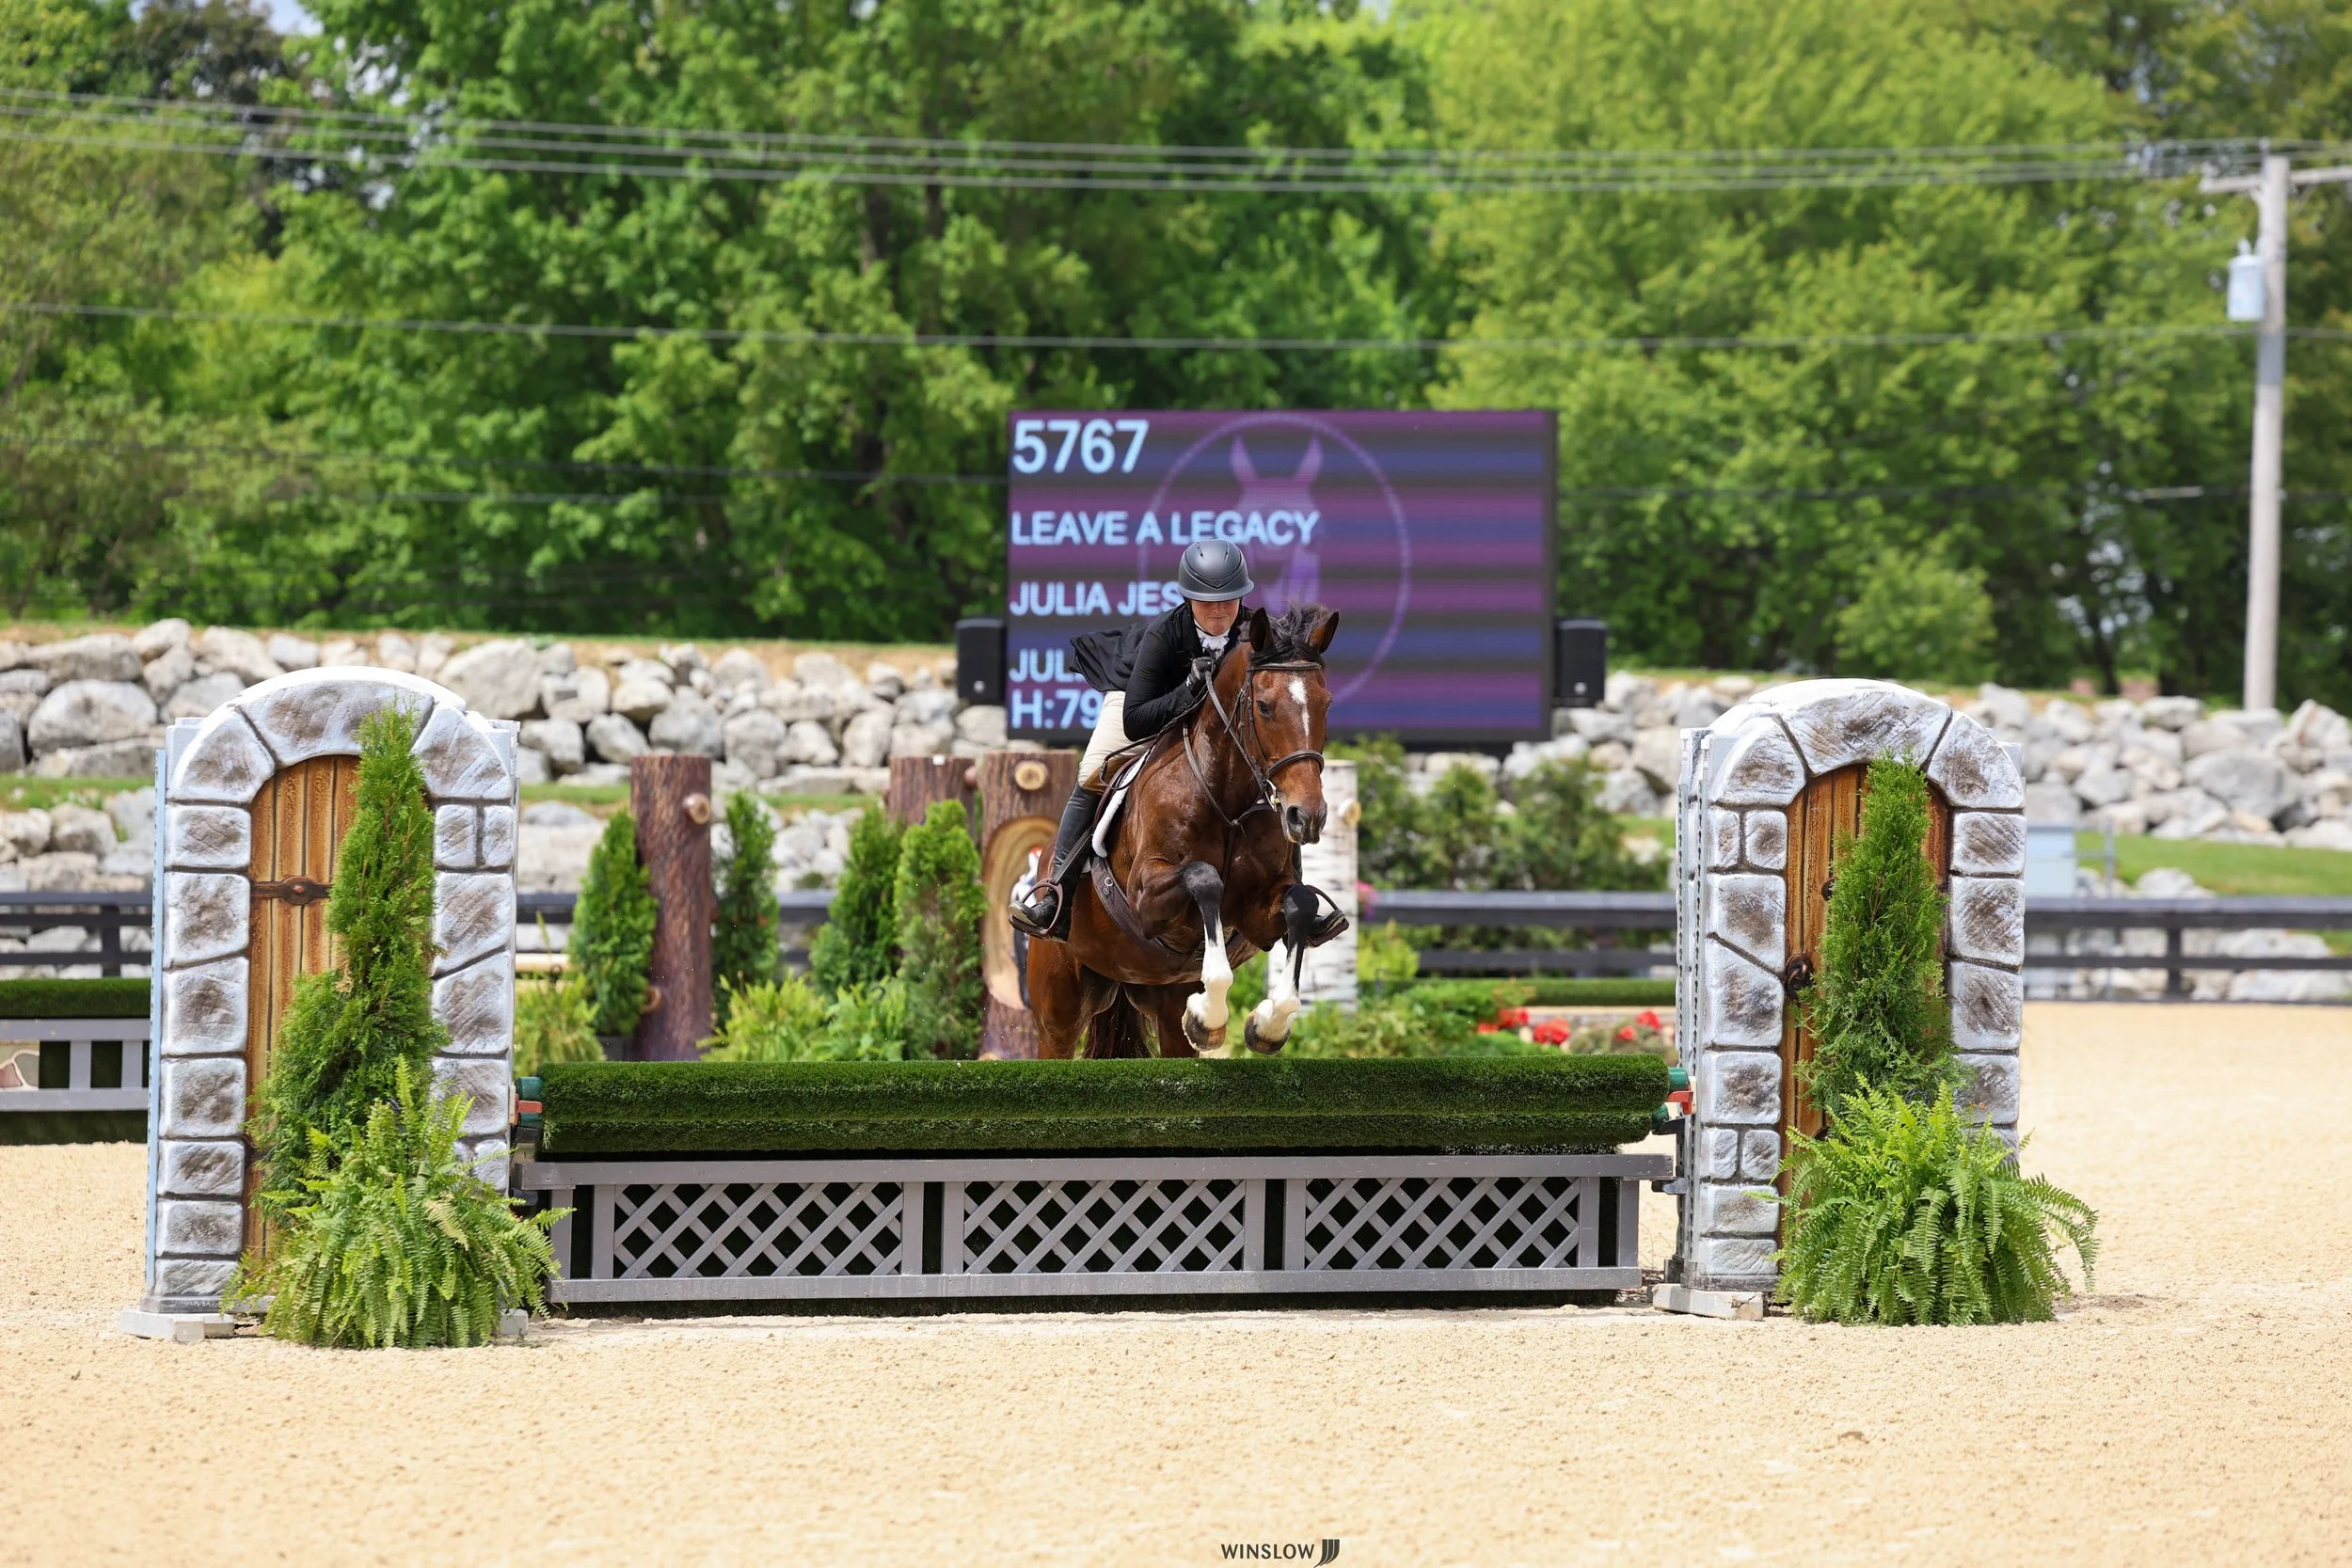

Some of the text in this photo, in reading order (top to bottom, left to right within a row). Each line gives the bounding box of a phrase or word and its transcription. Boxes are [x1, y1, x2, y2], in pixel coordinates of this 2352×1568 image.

[1012, 419, 1150, 473] 5767
[1011, 511, 1319, 546] LEAVE A LEGACY
[1009, 581, 1111, 615] JULIA
[1009, 648, 1085, 682] JUL
